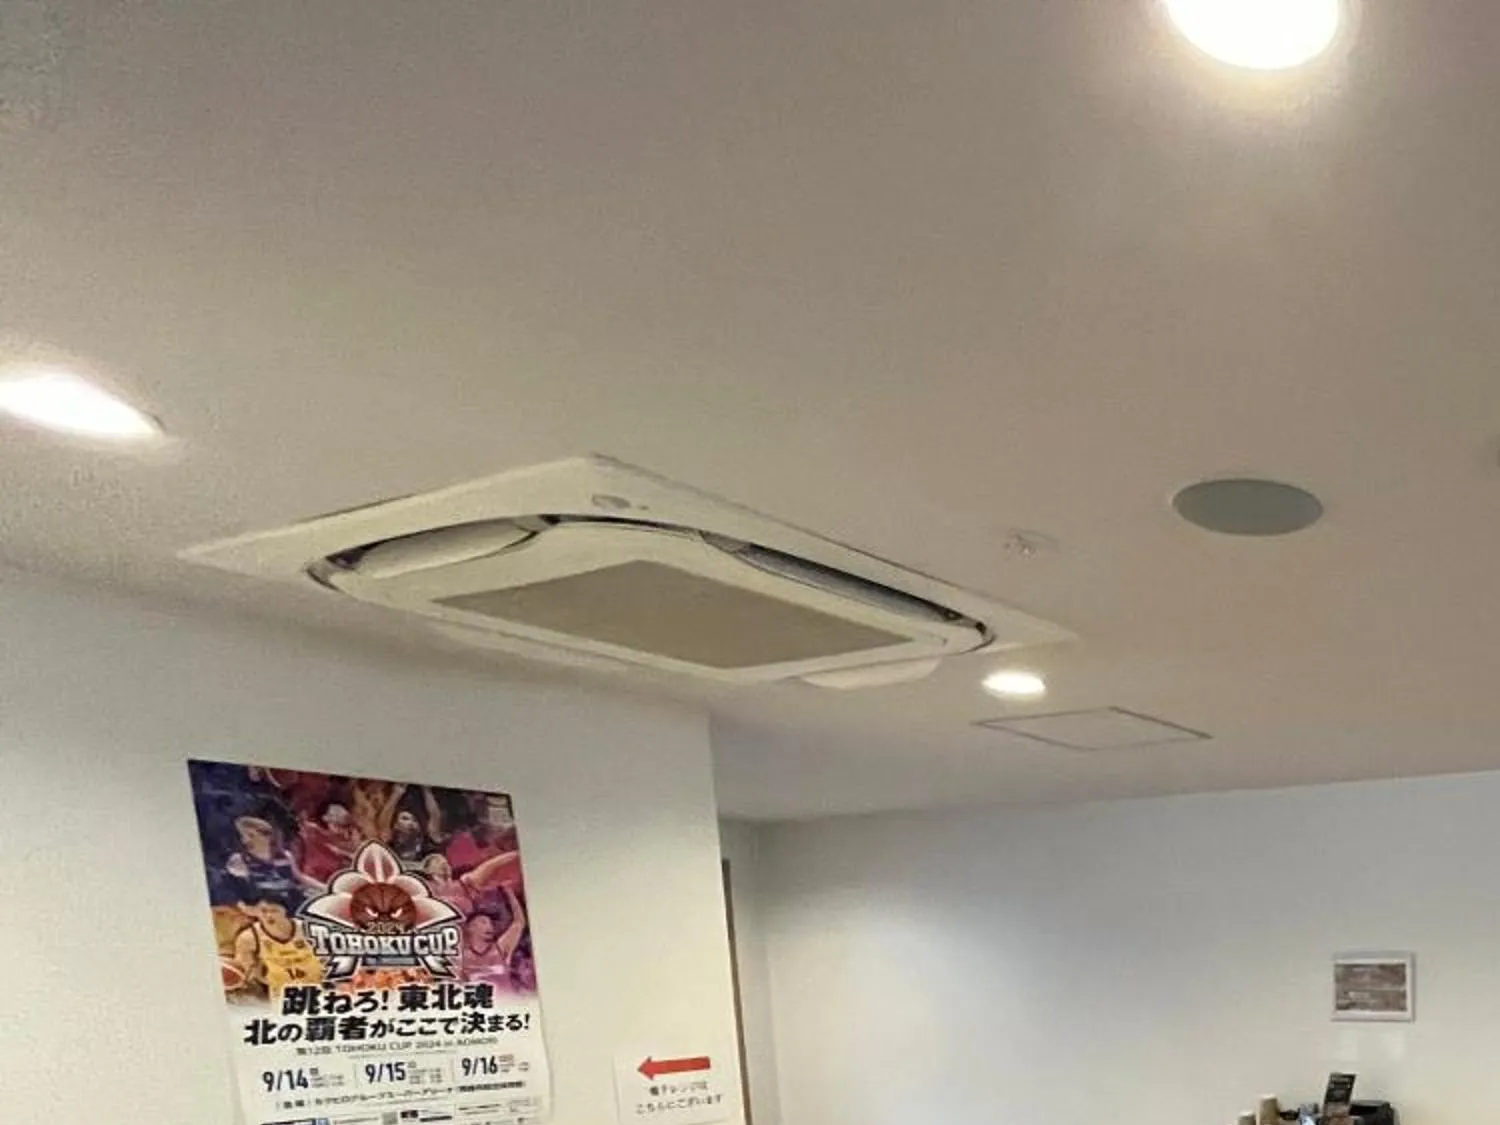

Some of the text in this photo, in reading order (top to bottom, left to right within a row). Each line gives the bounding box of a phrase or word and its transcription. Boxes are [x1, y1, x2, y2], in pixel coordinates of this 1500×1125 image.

[309, 925, 460, 956] TOHOKU CUP
[397, 983, 494, 1012] 東北魂
[365, 1061, 406, 1084] 9/15
[461, 1054, 498, 1077] 9/16
[262, 1068, 309, 1093] 9/14
